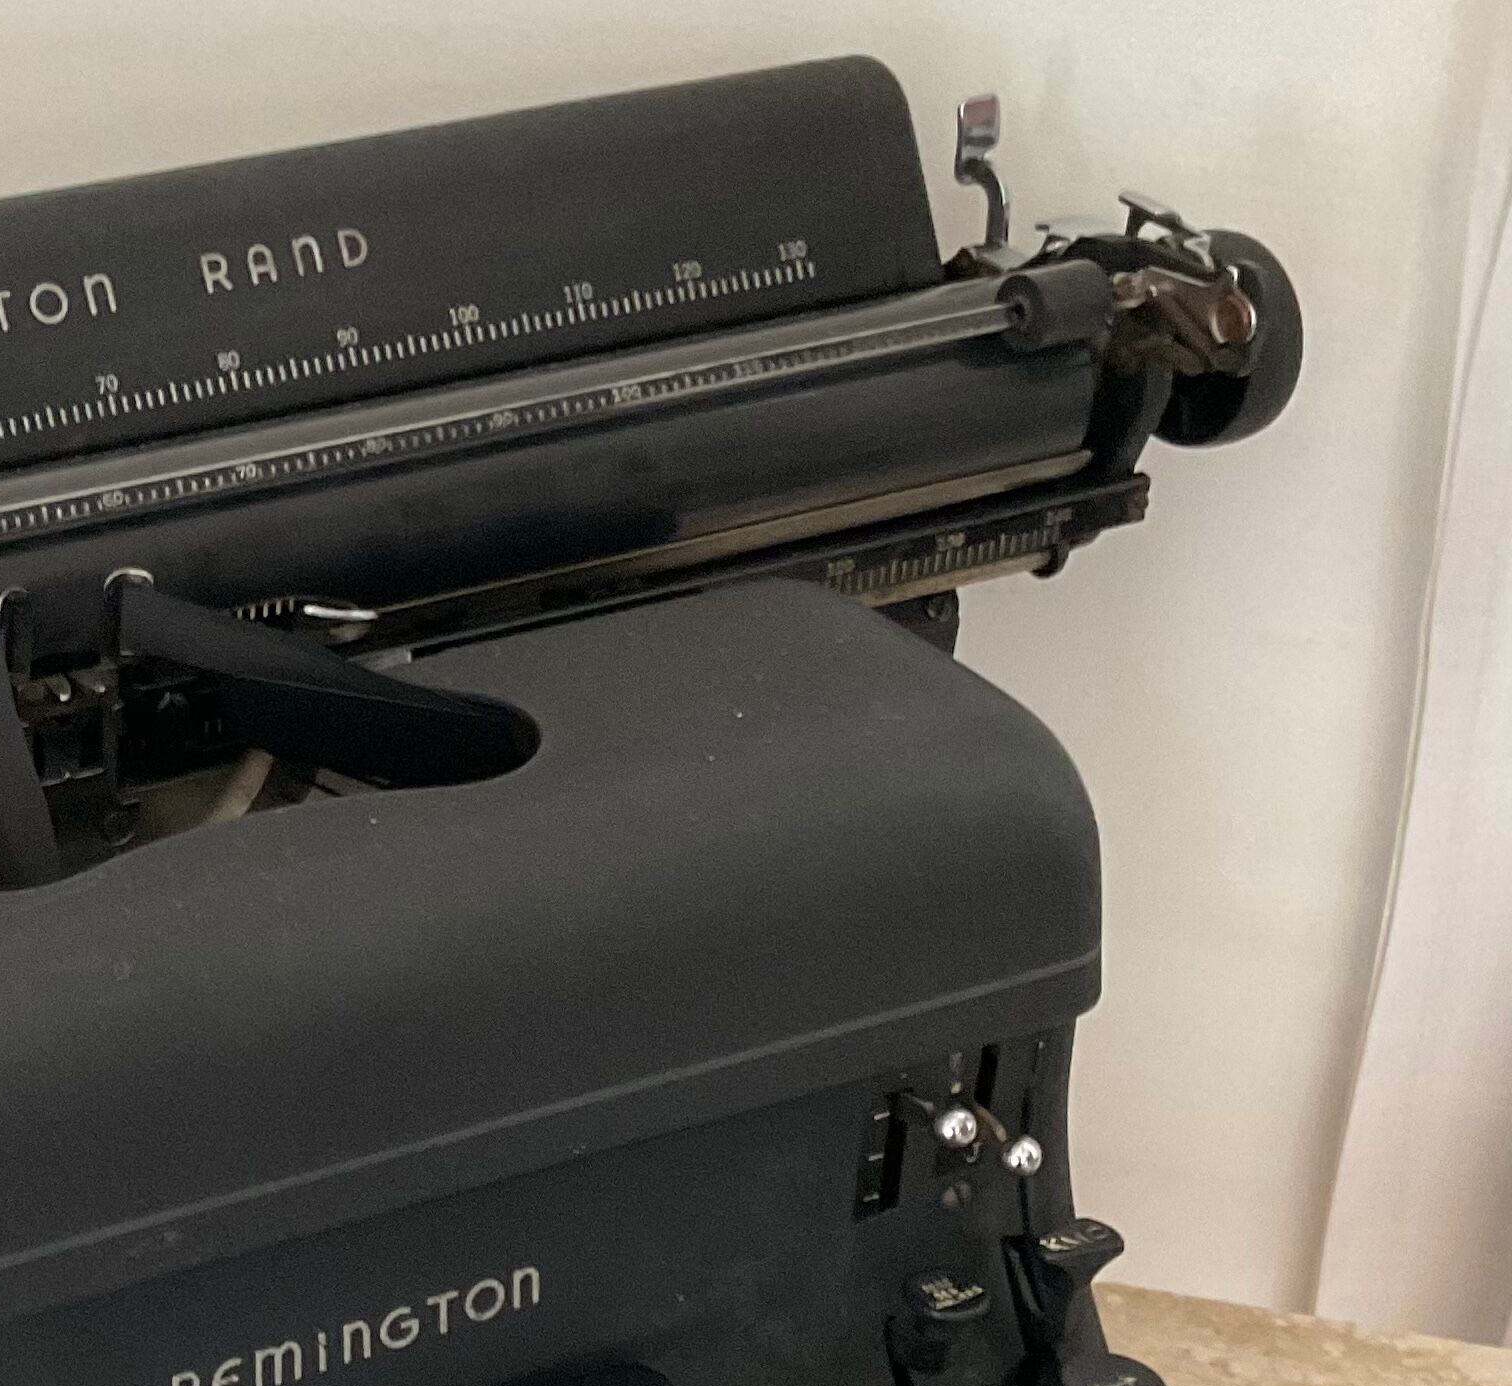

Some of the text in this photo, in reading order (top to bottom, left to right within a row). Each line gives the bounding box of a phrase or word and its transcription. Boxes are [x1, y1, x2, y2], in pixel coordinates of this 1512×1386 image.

[199, 228, 369, 296] RAND
[94, 374, 118, 394] 70
[218, 351, 240, 371] 80
[337, 326, 357, 348] 90
[449, 304, 478, 325] 100
[563, 281, 592, 303] 110
[237, 463, 256, 479] 70
